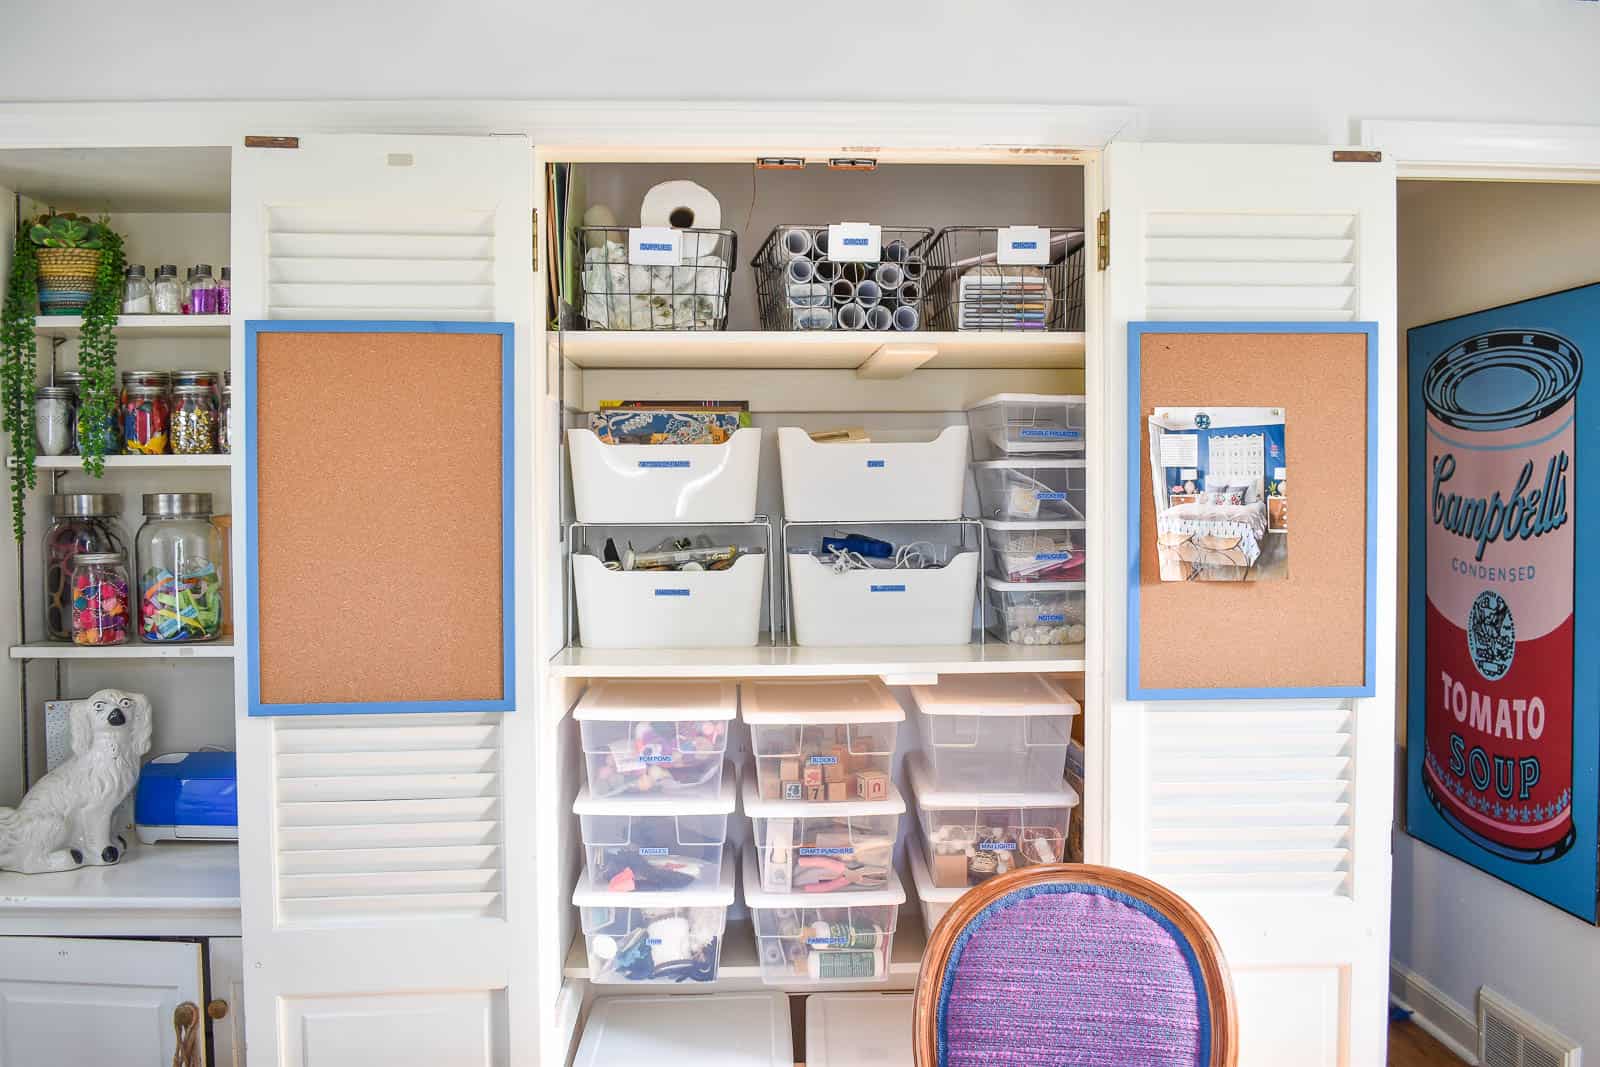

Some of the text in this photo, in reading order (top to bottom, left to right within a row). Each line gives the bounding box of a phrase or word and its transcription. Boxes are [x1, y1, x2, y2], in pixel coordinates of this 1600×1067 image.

[1432, 450, 1568, 561] Campbell's
[1451, 557, 1536, 582] CONDENSED
[1441, 671, 1545, 740] TOMATO
[1450, 733, 1540, 799] SOUP
